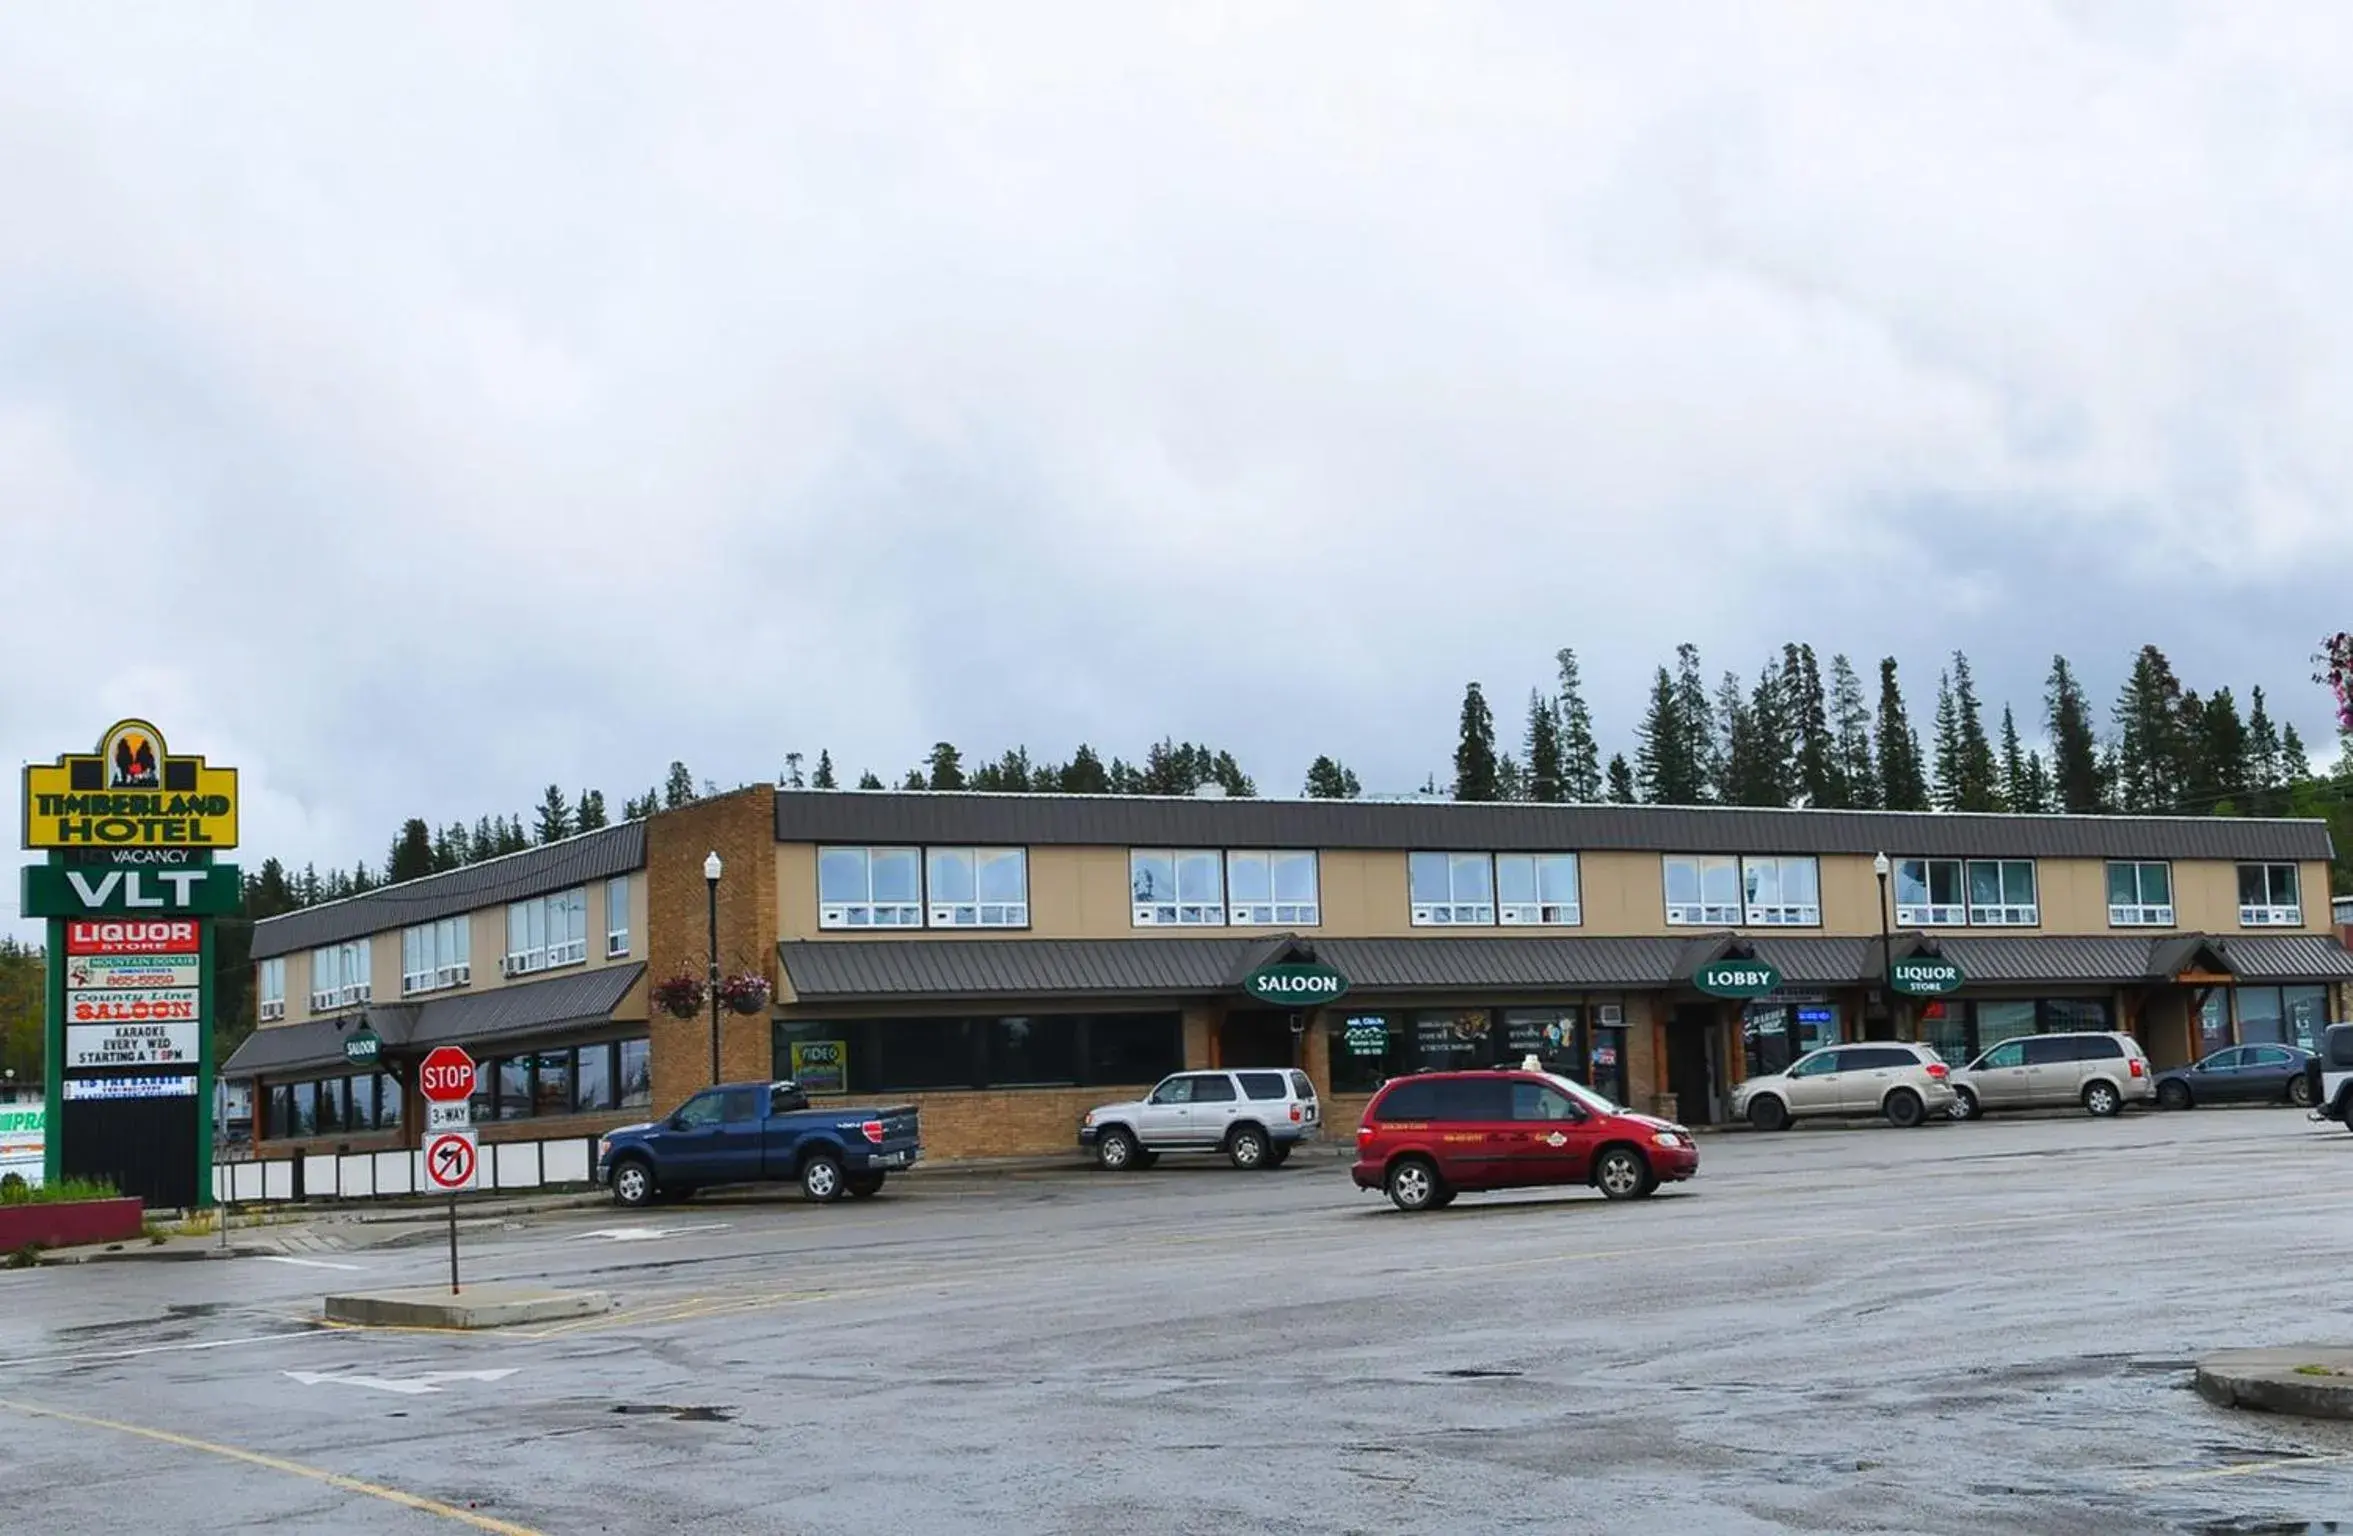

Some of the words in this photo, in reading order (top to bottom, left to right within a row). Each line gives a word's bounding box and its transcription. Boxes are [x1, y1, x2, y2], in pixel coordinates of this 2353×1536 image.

[36, 794, 230, 817] TIMBERLAND
[59, 818, 212, 842] HOTEL
[111, 849, 190, 863] VACANCY
[66, 871, 208, 907] VLT
[74, 923, 192, 942] LIQUOR
[100, 942, 168, 951] STORE
[91, 957, 150, 968] MOUNTAIN
[1707, 971, 1771, 986] LOBBY
[1895, 966, 1956, 980] LIQUOR
[1256, 975, 1338, 993] SALOON
[1910, 981, 1941, 991] STORE
[73, 993, 144, 1004] County
[150, 991, 193, 1001] Line
[74, 1001, 193, 1020] SALOON
[115, 1026, 166, 1038] KARAOKE
[103, 1039, 139, 1050] EVERY
[147, 1038, 171, 1049] WED
[79, 1051, 136, 1064] STARTING
[426, 1067, 471, 1089] STOP
[432, 1108, 467, 1124] 3-WAY
